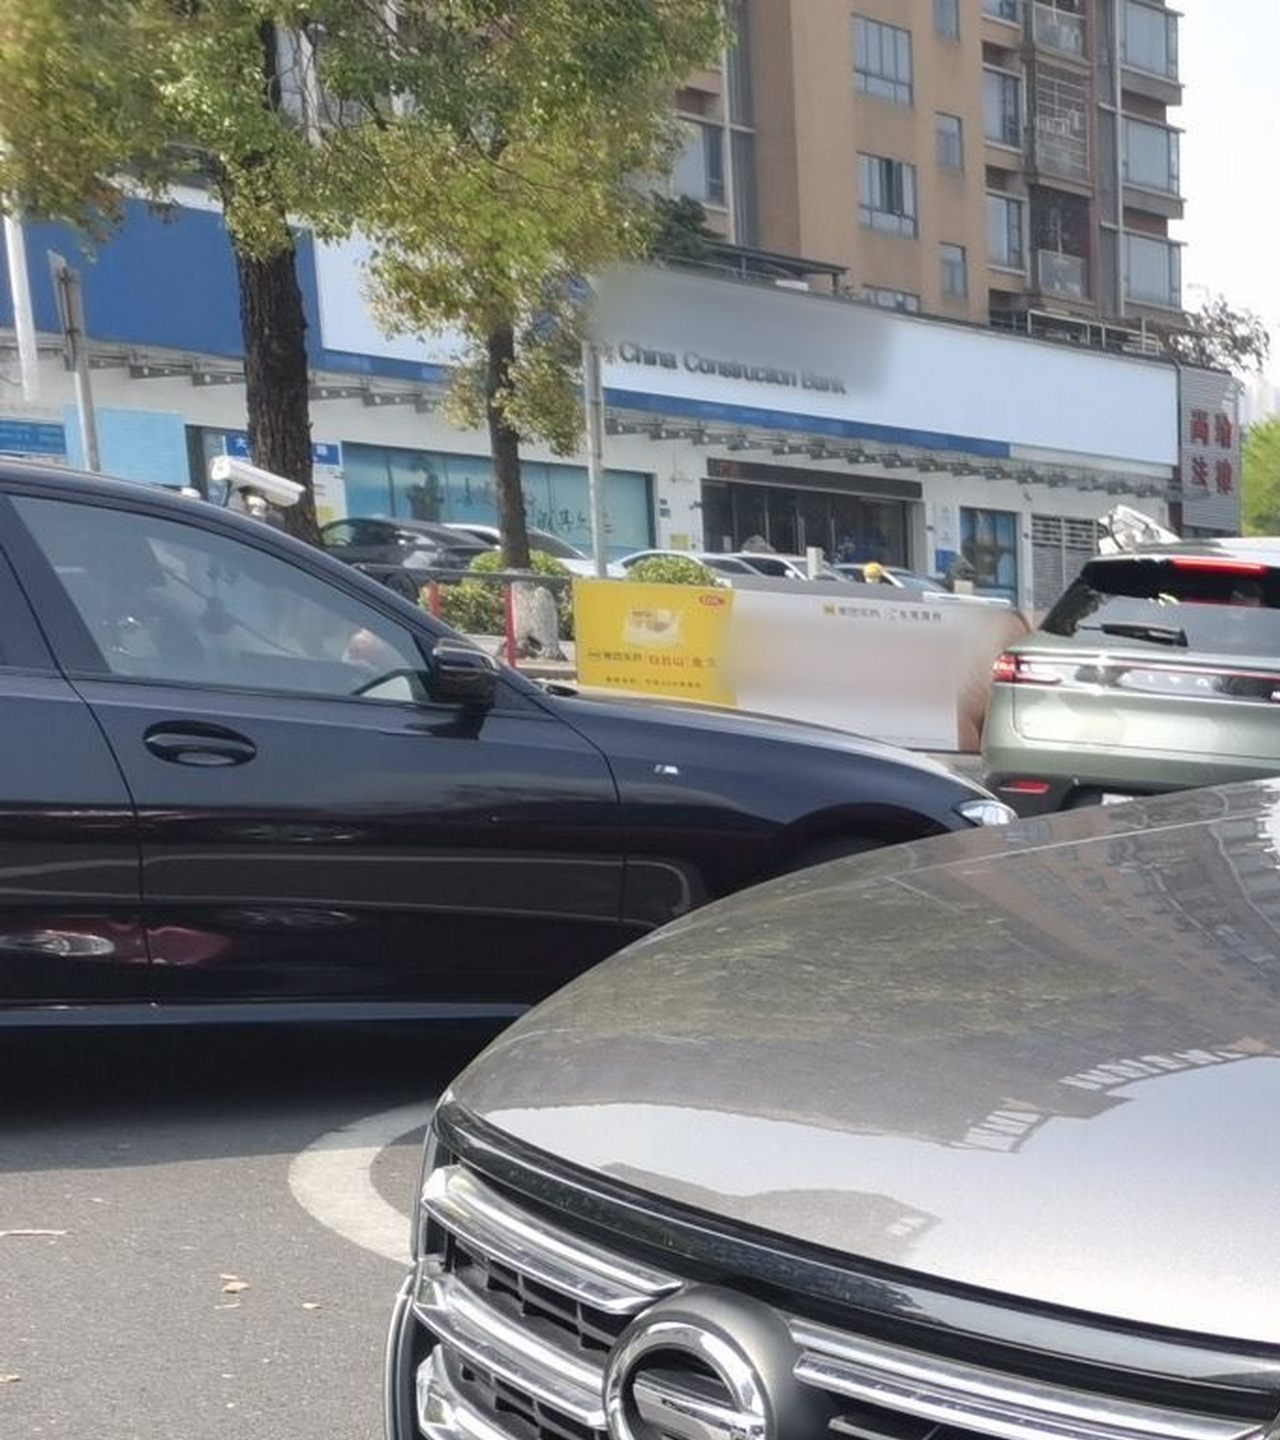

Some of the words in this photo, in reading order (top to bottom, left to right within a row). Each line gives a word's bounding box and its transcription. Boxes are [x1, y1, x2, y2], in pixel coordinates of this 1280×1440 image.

[618, 340, 678, 370] China
[683, 352, 798, 388] Construction
[800, 369, 847, 395] Bank
